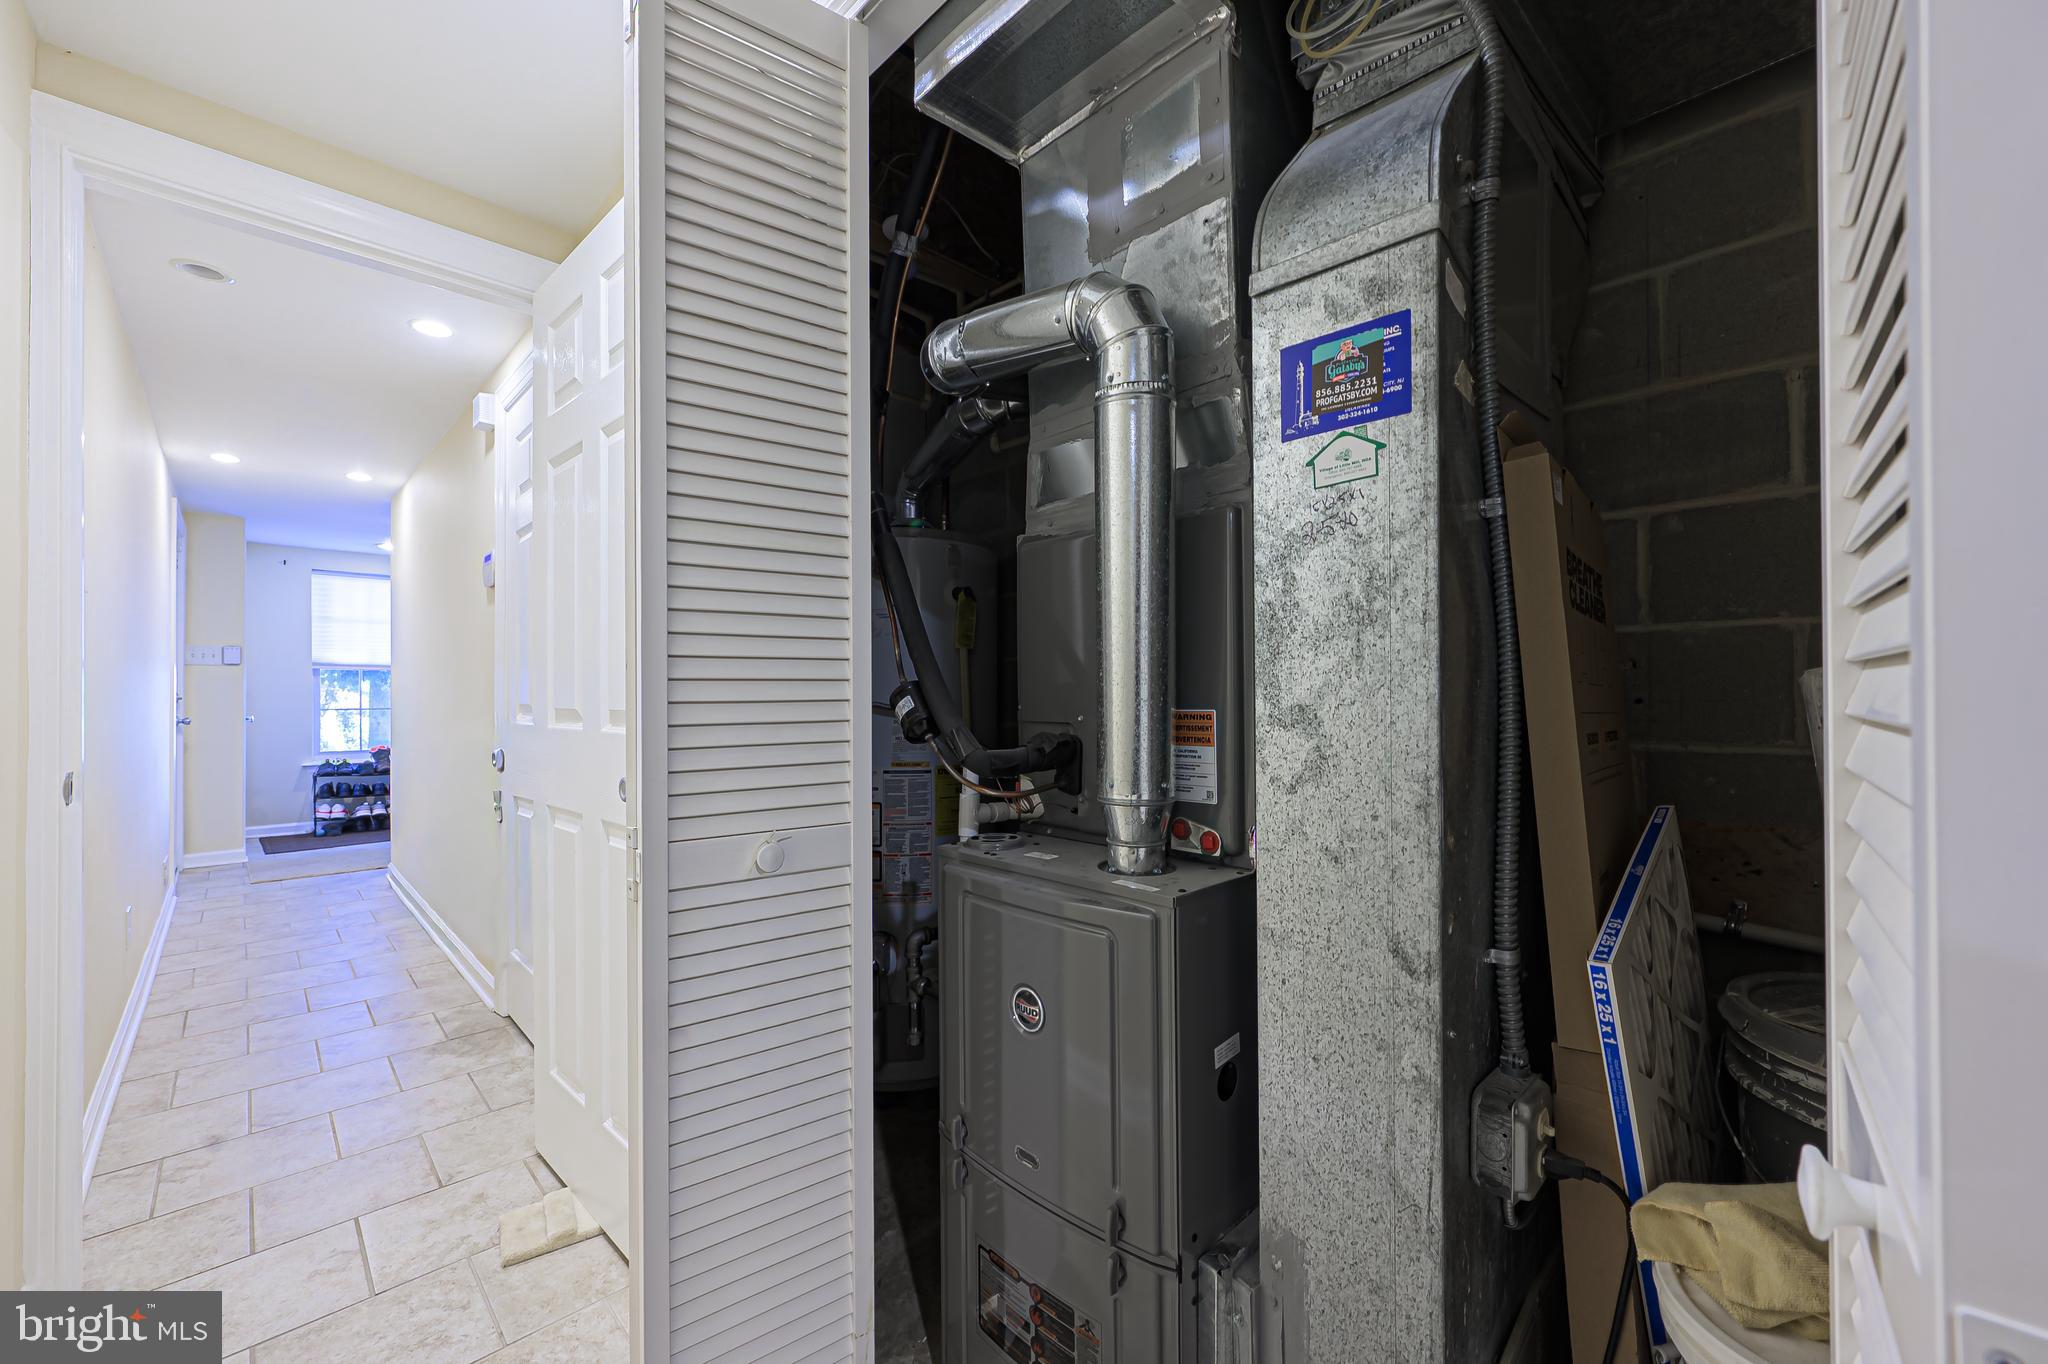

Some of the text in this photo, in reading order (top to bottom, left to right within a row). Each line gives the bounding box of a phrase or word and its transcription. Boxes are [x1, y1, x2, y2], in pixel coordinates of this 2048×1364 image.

[1383, 325, 1402, 336] INC.
[1328, 360, 1365, 379] Gatsby's
[1315, 376, 1377, 398] 856.885.2231
[1315, 386, 1378, 407] PROFGATSBY.COM
[1175, 735, 1212, 744] DVERTENCIA
[1608, 918, 1622, 929] 16
[1592, 973, 1608, 990] 16
[1015, 1003, 1038, 1017] RUUD
[1597, 1003, 1614, 1023] 25
[1604, 1037, 1617, 1045] 1
